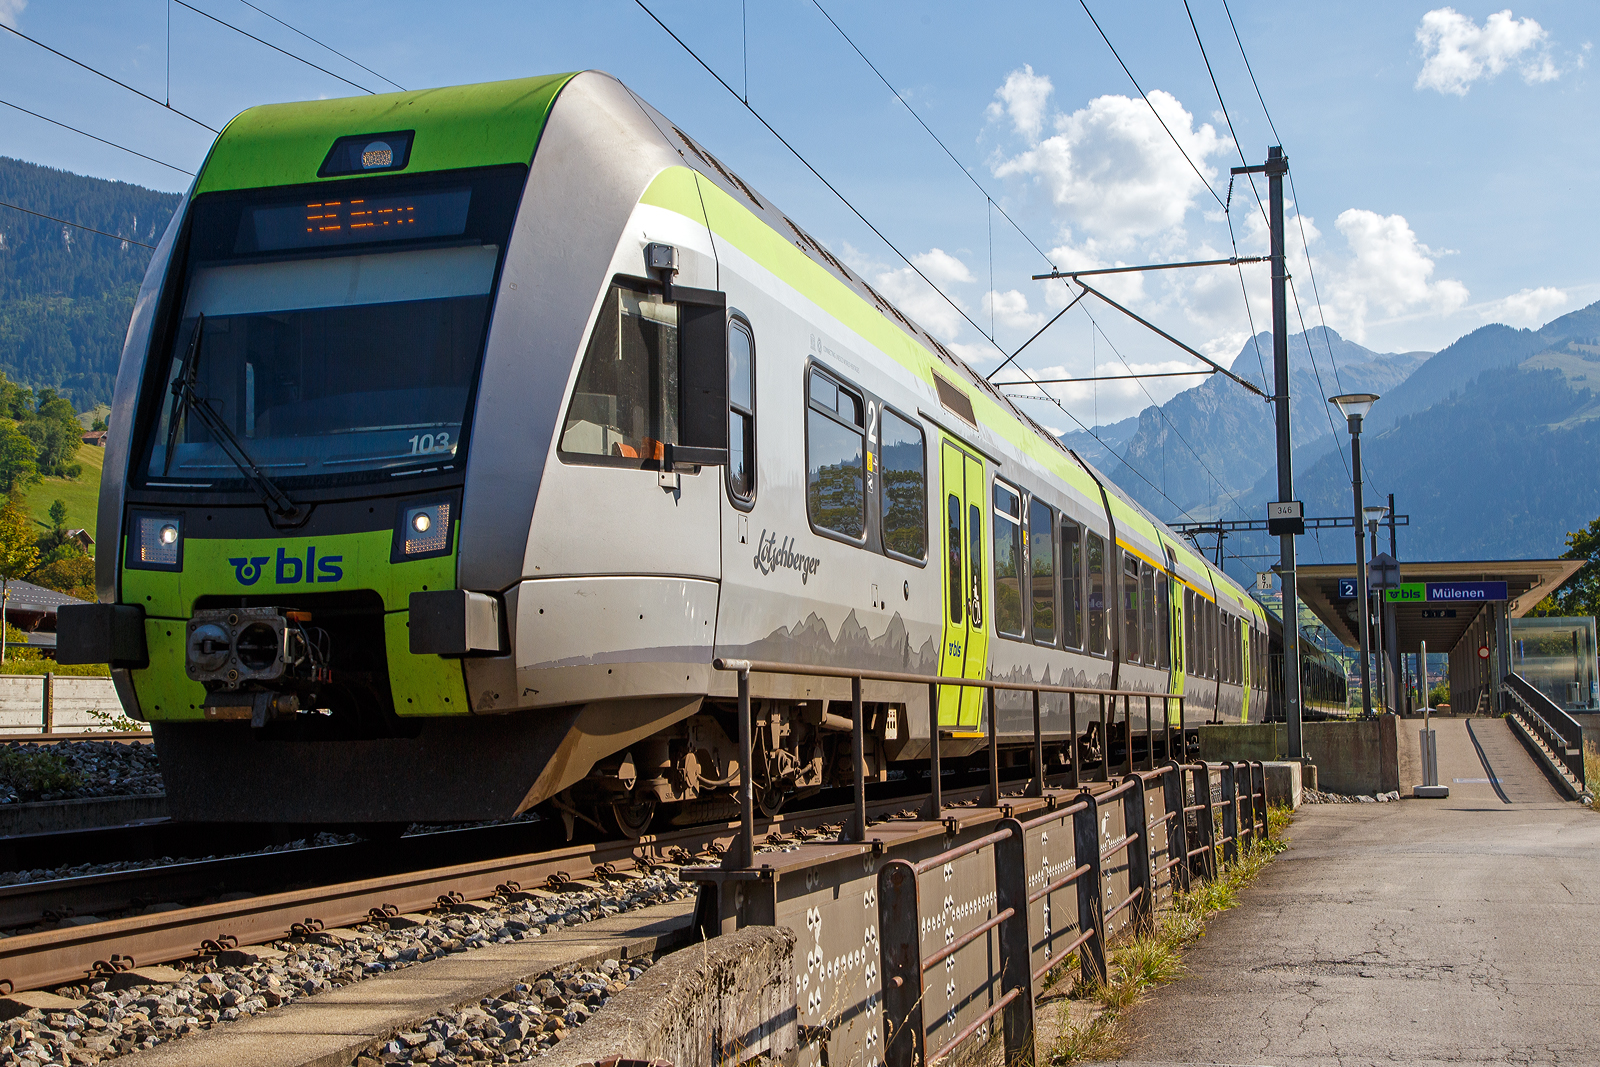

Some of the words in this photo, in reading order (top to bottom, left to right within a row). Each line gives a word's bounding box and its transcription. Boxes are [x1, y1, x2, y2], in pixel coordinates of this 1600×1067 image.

[867, 400, 877, 445] 2
[408, 432, 450, 455] 103
[1277, 506, 1293, 515] 346
[275, 546, 344, 584] bls
[1345, 584, 1354, 595] 2
[1401, 589, 1421, 599] bls
[1432, 588, 1485, 599] Mülenen
